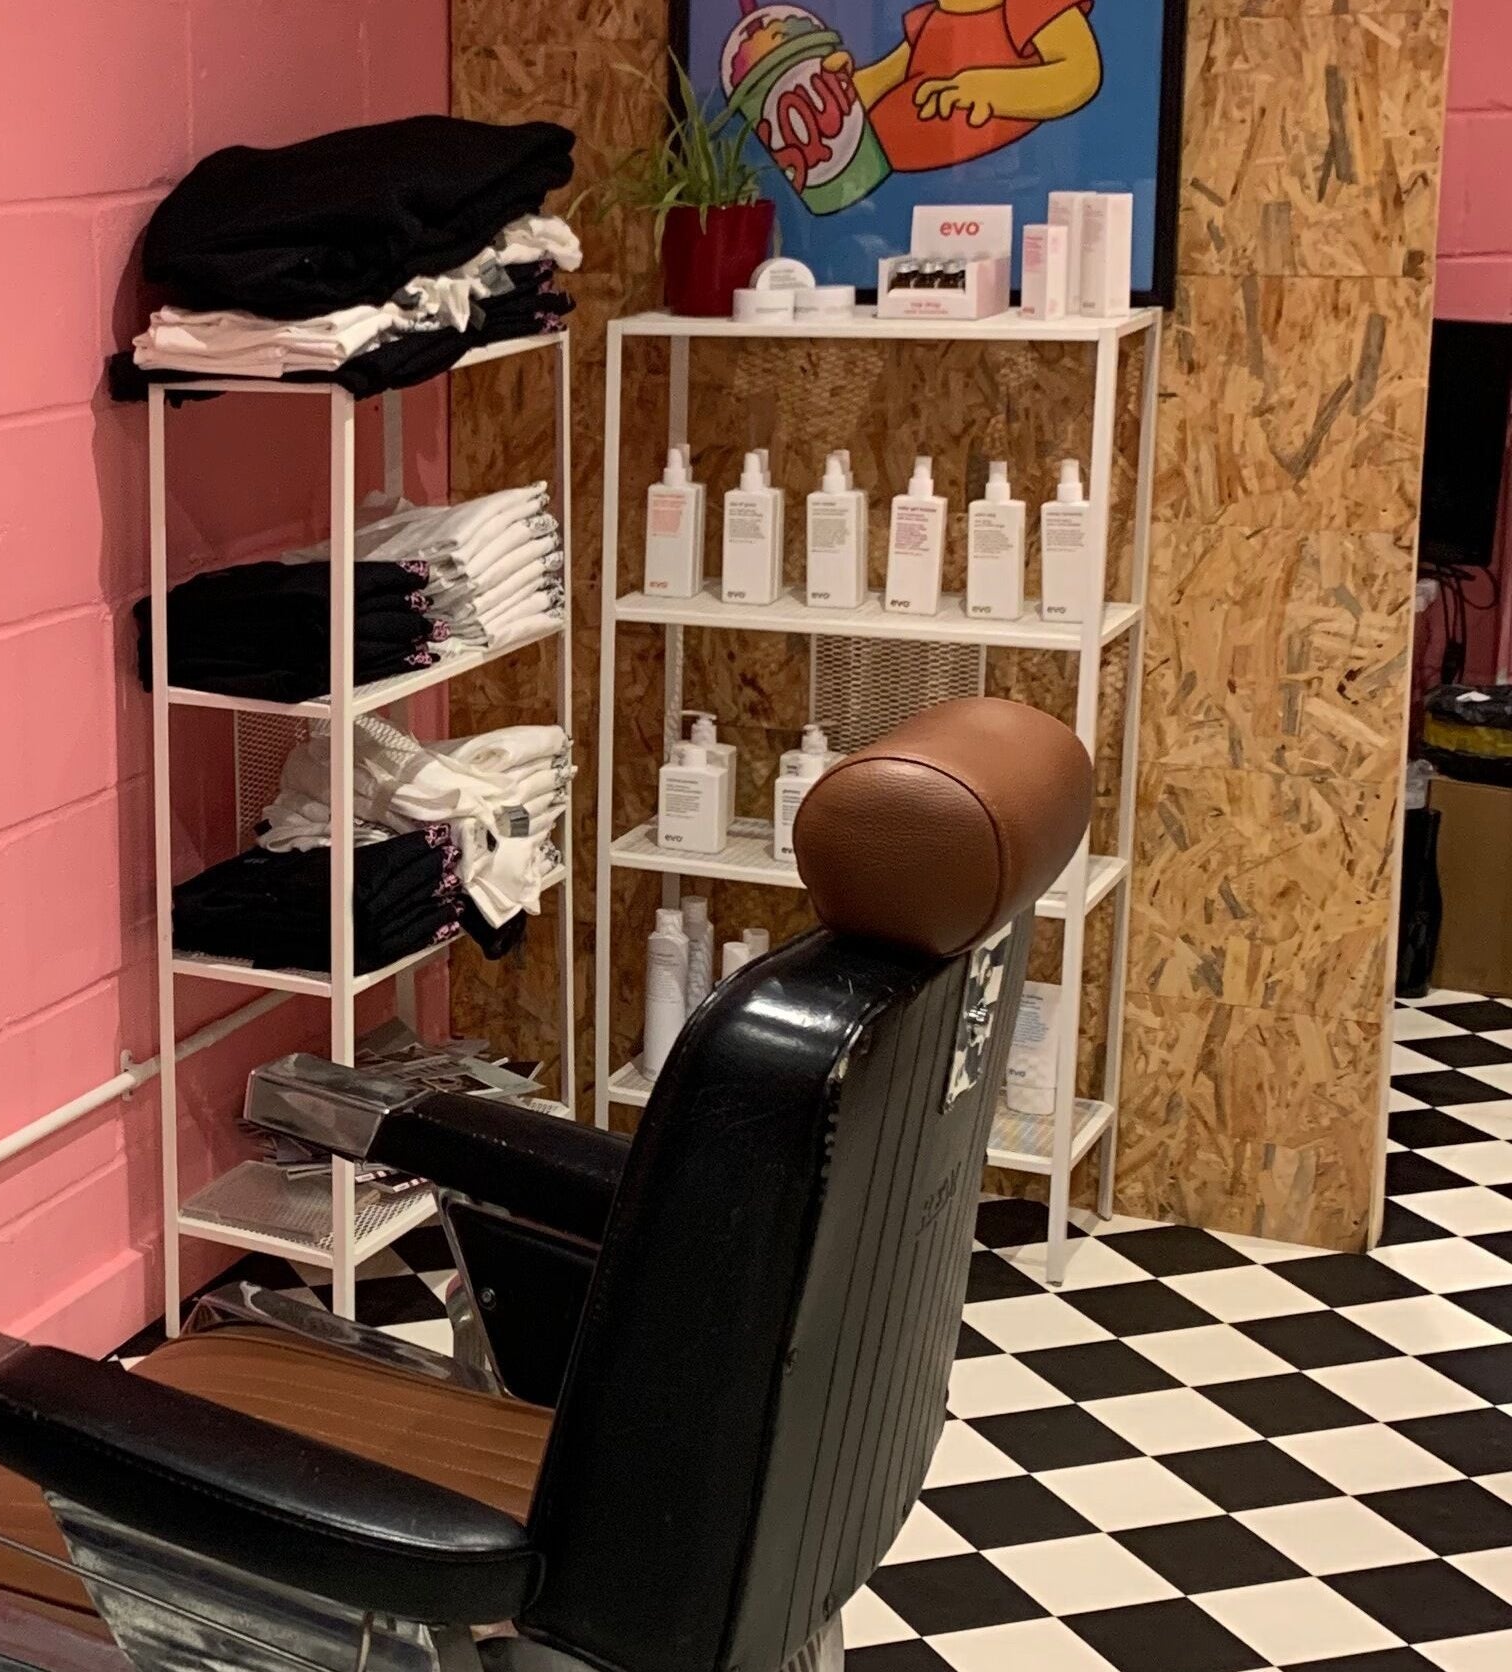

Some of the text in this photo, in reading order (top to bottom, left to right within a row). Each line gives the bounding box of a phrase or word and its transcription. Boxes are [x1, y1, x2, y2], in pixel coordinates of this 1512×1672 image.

[940, 221, 980, 236] evo
[649, 581, 668, 589] evo
[727, 591, 746, 599] evo
[811, 592, 830, 600] evo
[890, 599, 910, 608] evo
[972, 605, 992, 614] evo
[1046, 606, 1066, 614] evo
[664, 833, 683, 843] evo
